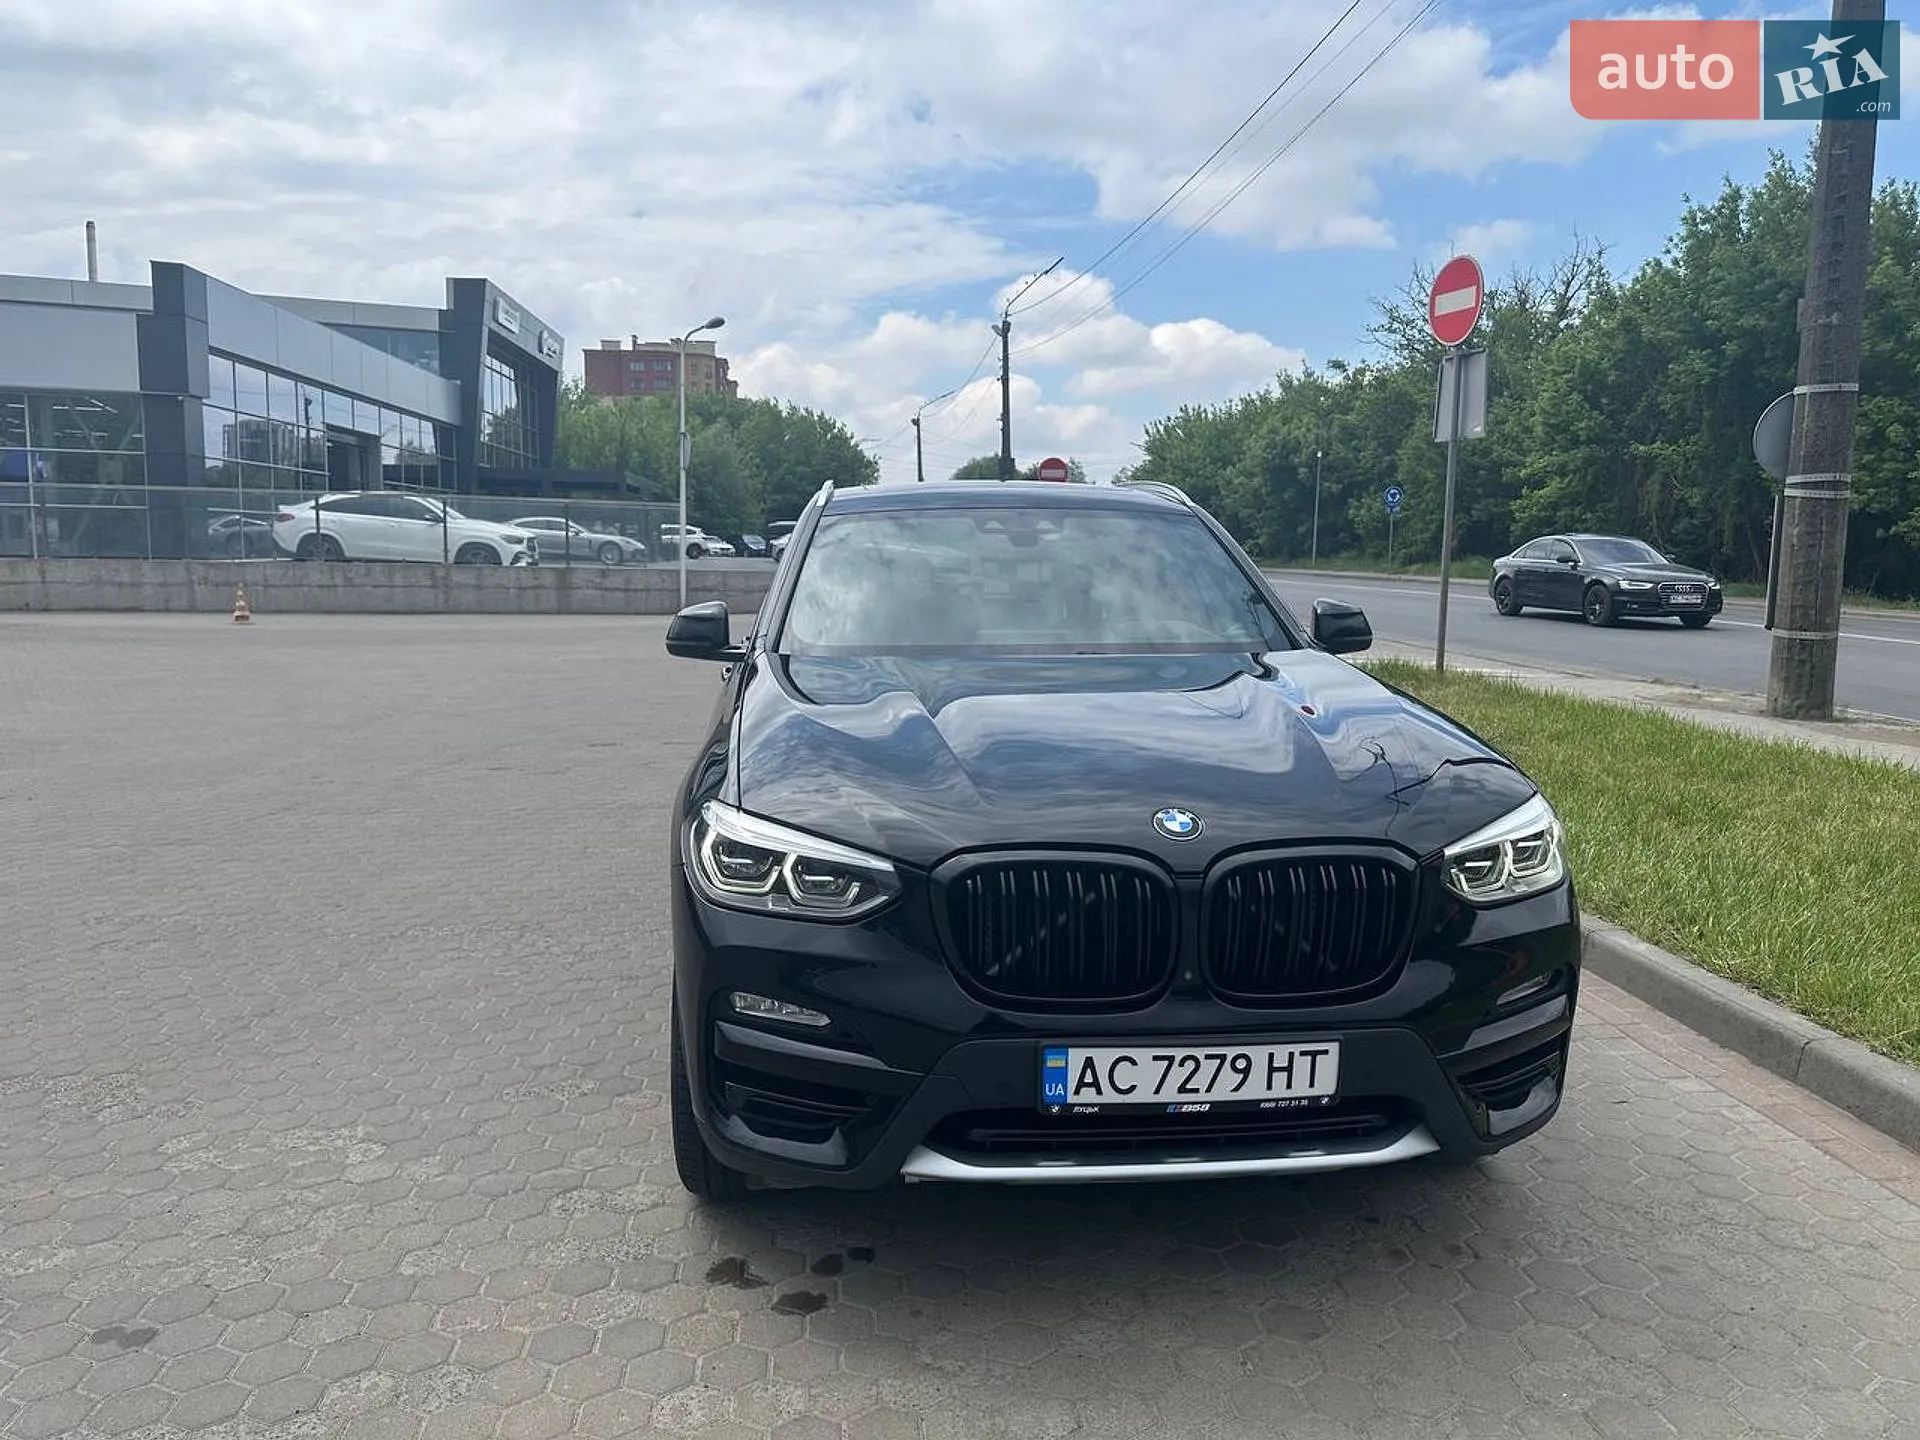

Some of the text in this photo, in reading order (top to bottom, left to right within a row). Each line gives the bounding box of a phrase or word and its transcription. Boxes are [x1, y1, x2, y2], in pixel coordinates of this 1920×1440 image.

[1073, 1049, 1329, 1096] AC 7279 HT
[1045, 1083, 1065, 1096] UA
